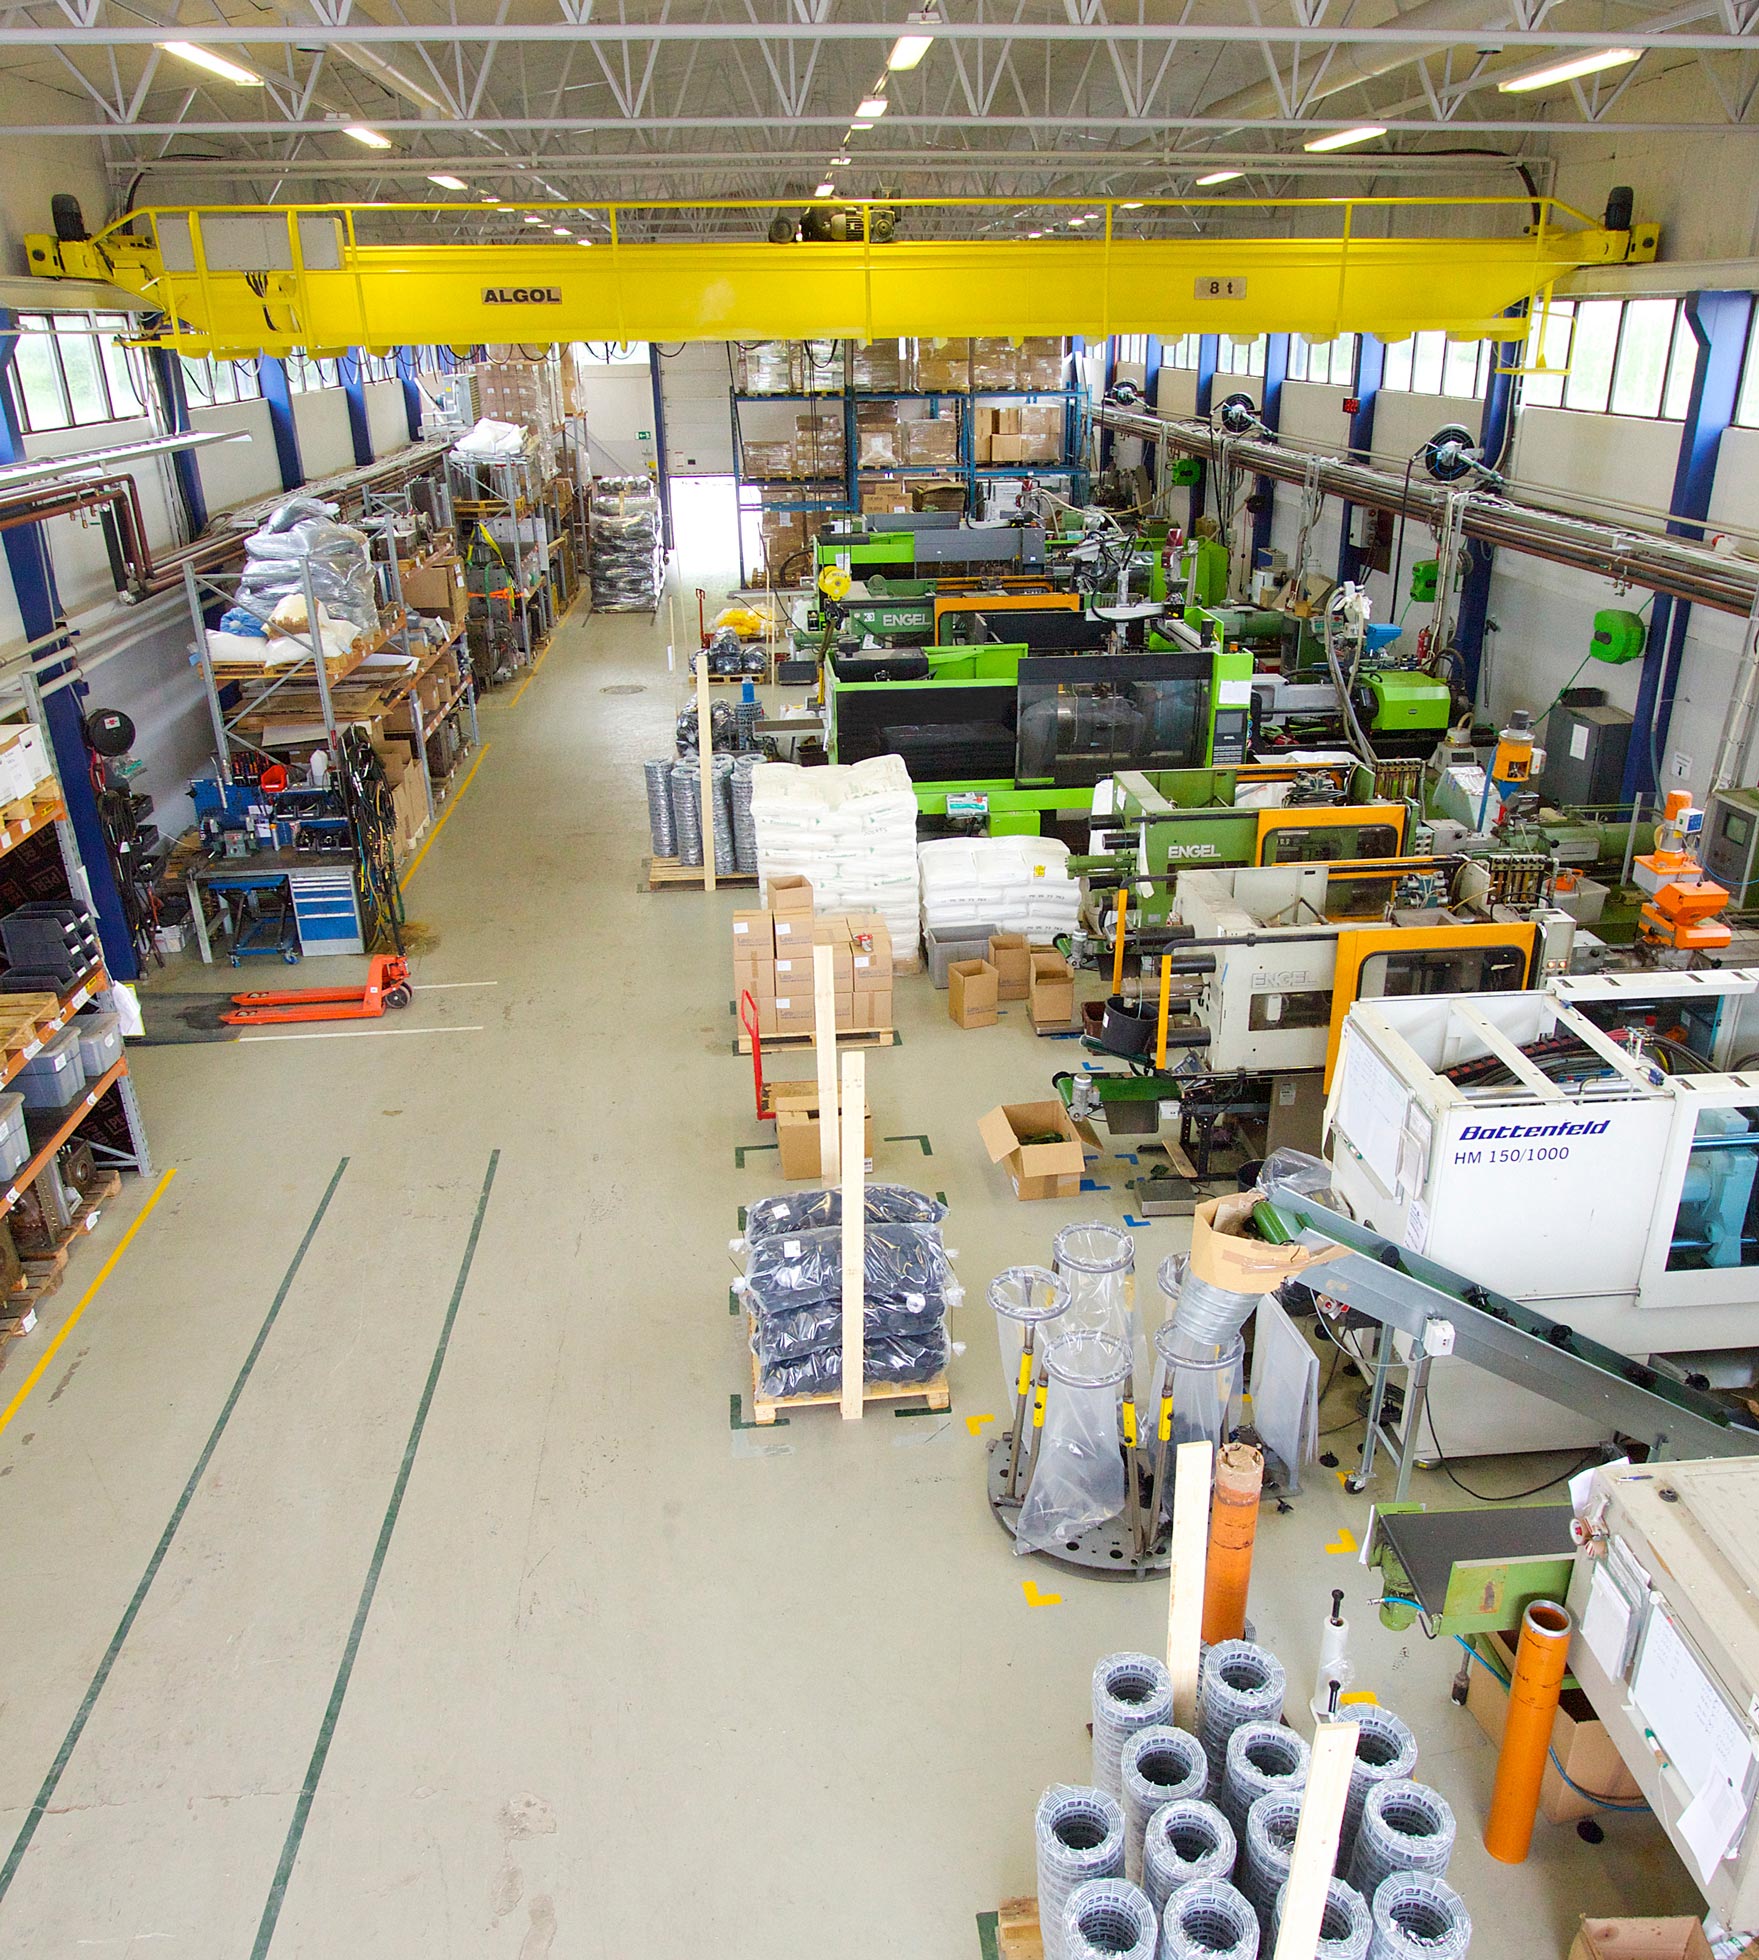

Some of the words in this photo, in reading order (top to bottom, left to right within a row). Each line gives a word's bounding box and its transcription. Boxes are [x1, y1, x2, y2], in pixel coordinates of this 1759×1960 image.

[1210, 281, 1219, 294] 8
[1227, 282, 1233, 294] t
[484, 289, 560, 303] ALGOL
[883, 613, 932, 627] ENGEL
[1168, 844, 1221, 859] ENGEL
[1251, 971, 1318, 989] ENGEL
[1459, 1120, 1611, 1141] Battenfeld
[1454, 1152, 1481, 1165] HM
[1489, 1147, 1570, 1163] 150/1000
